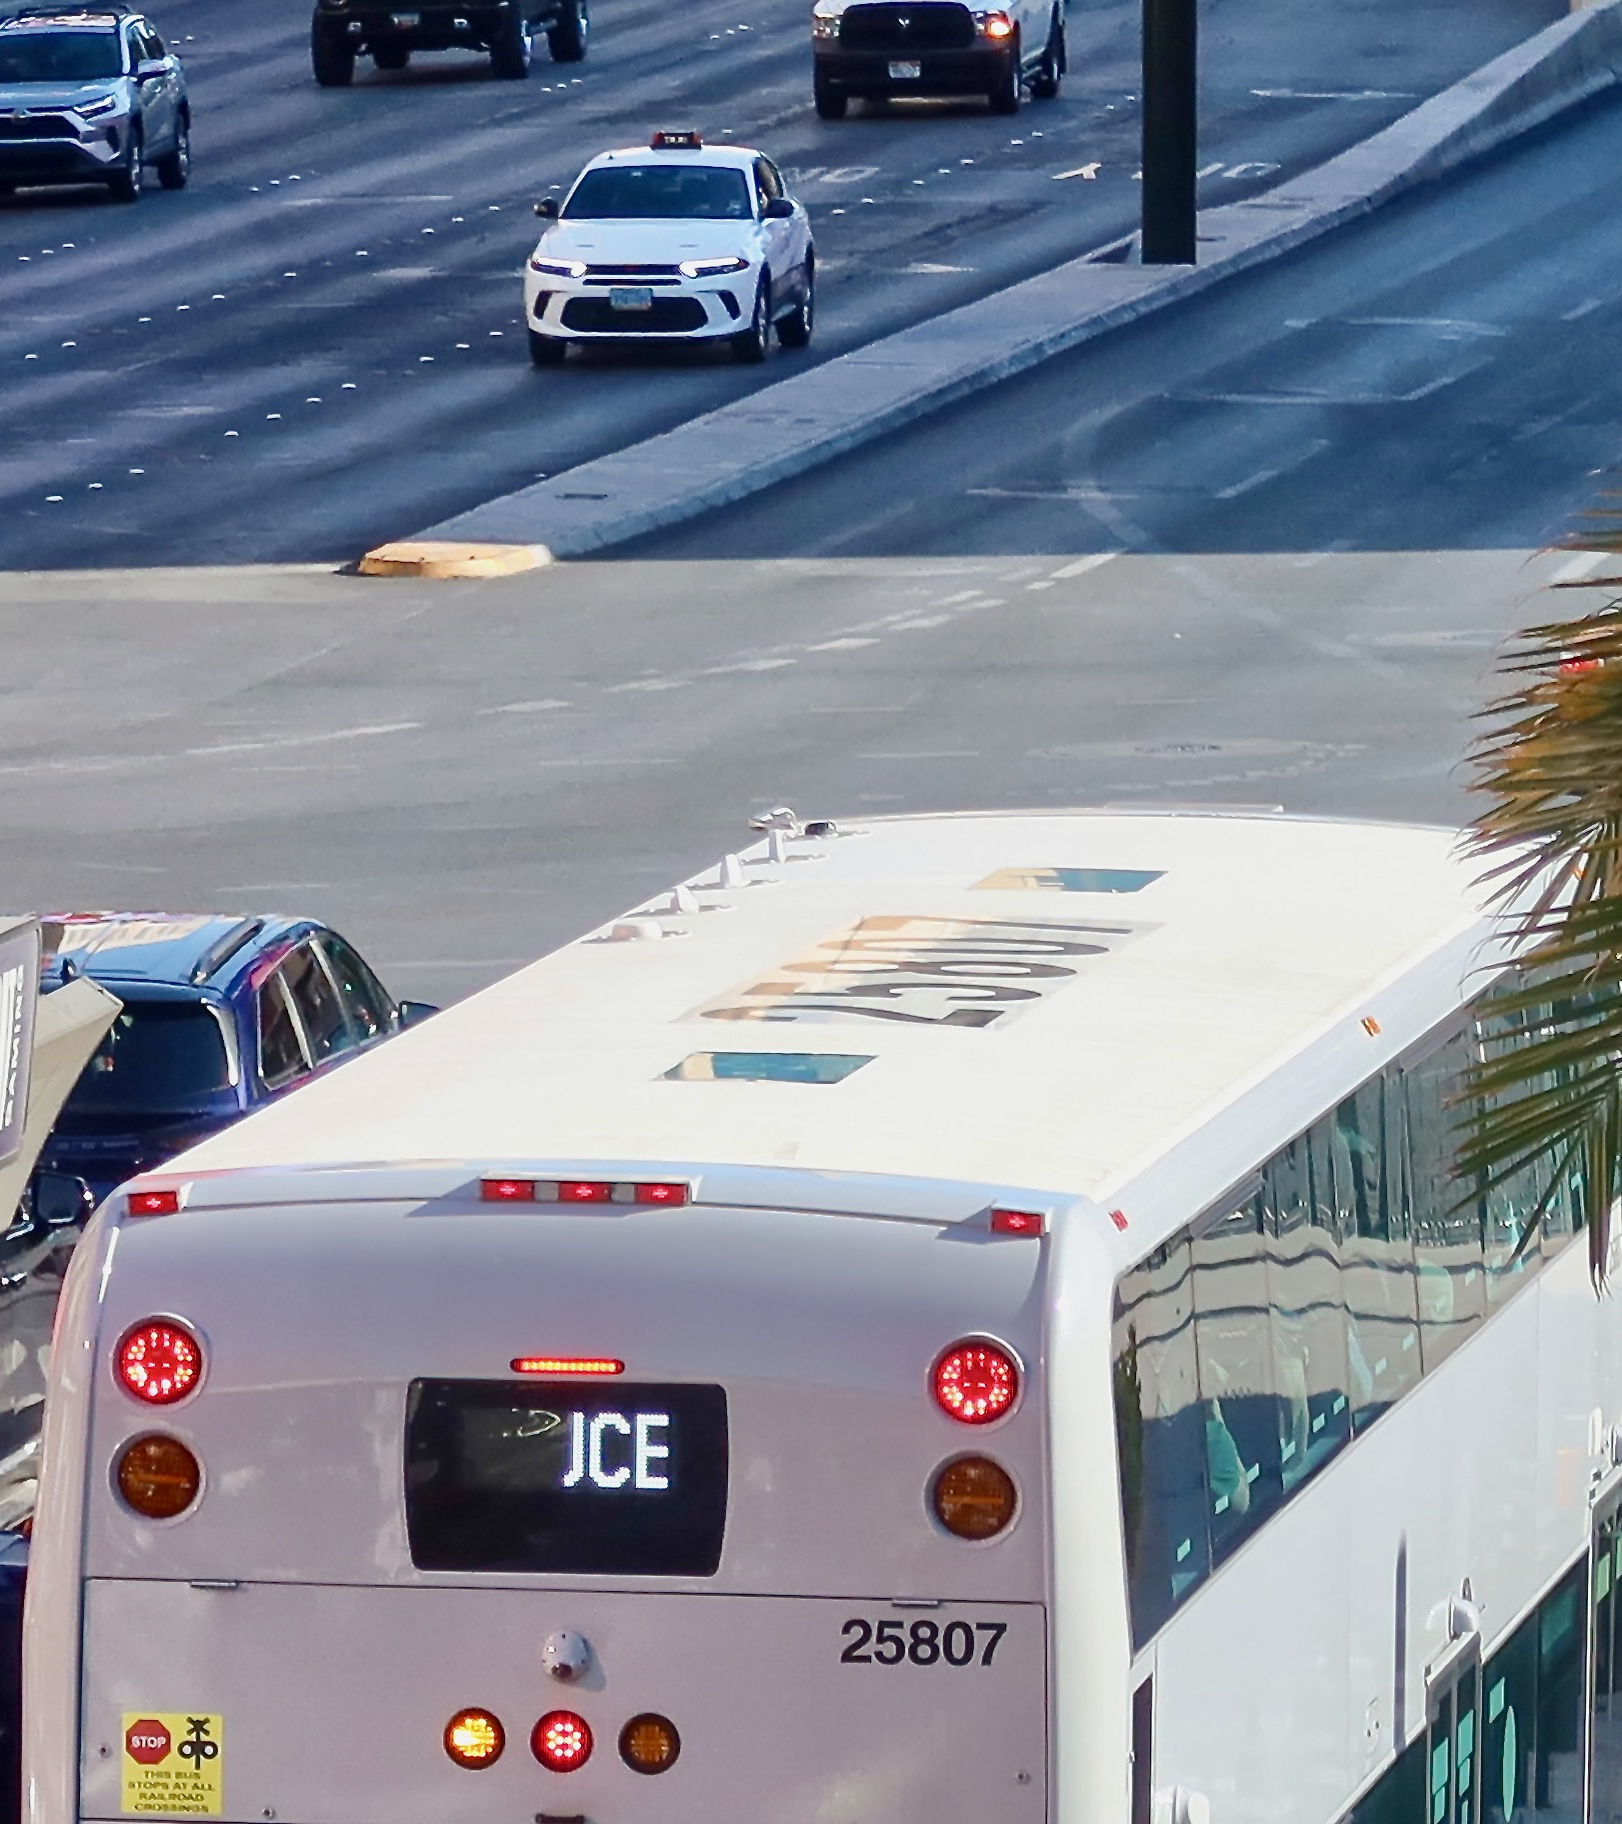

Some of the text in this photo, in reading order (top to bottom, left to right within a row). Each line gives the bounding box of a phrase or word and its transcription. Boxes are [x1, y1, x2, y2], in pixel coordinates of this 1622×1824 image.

[840, 1618, 1008, 1667] 25807
[131, 1735, 166, 1749] STOP
[144, 1770, 201, 1780] THIS BUS
[127, 1780, 214, 1792] STOPS AT ALL
[138, 1792, 205, 1802] RAILROAD
[134, 1803, 209, 1813] CROSSINGS
